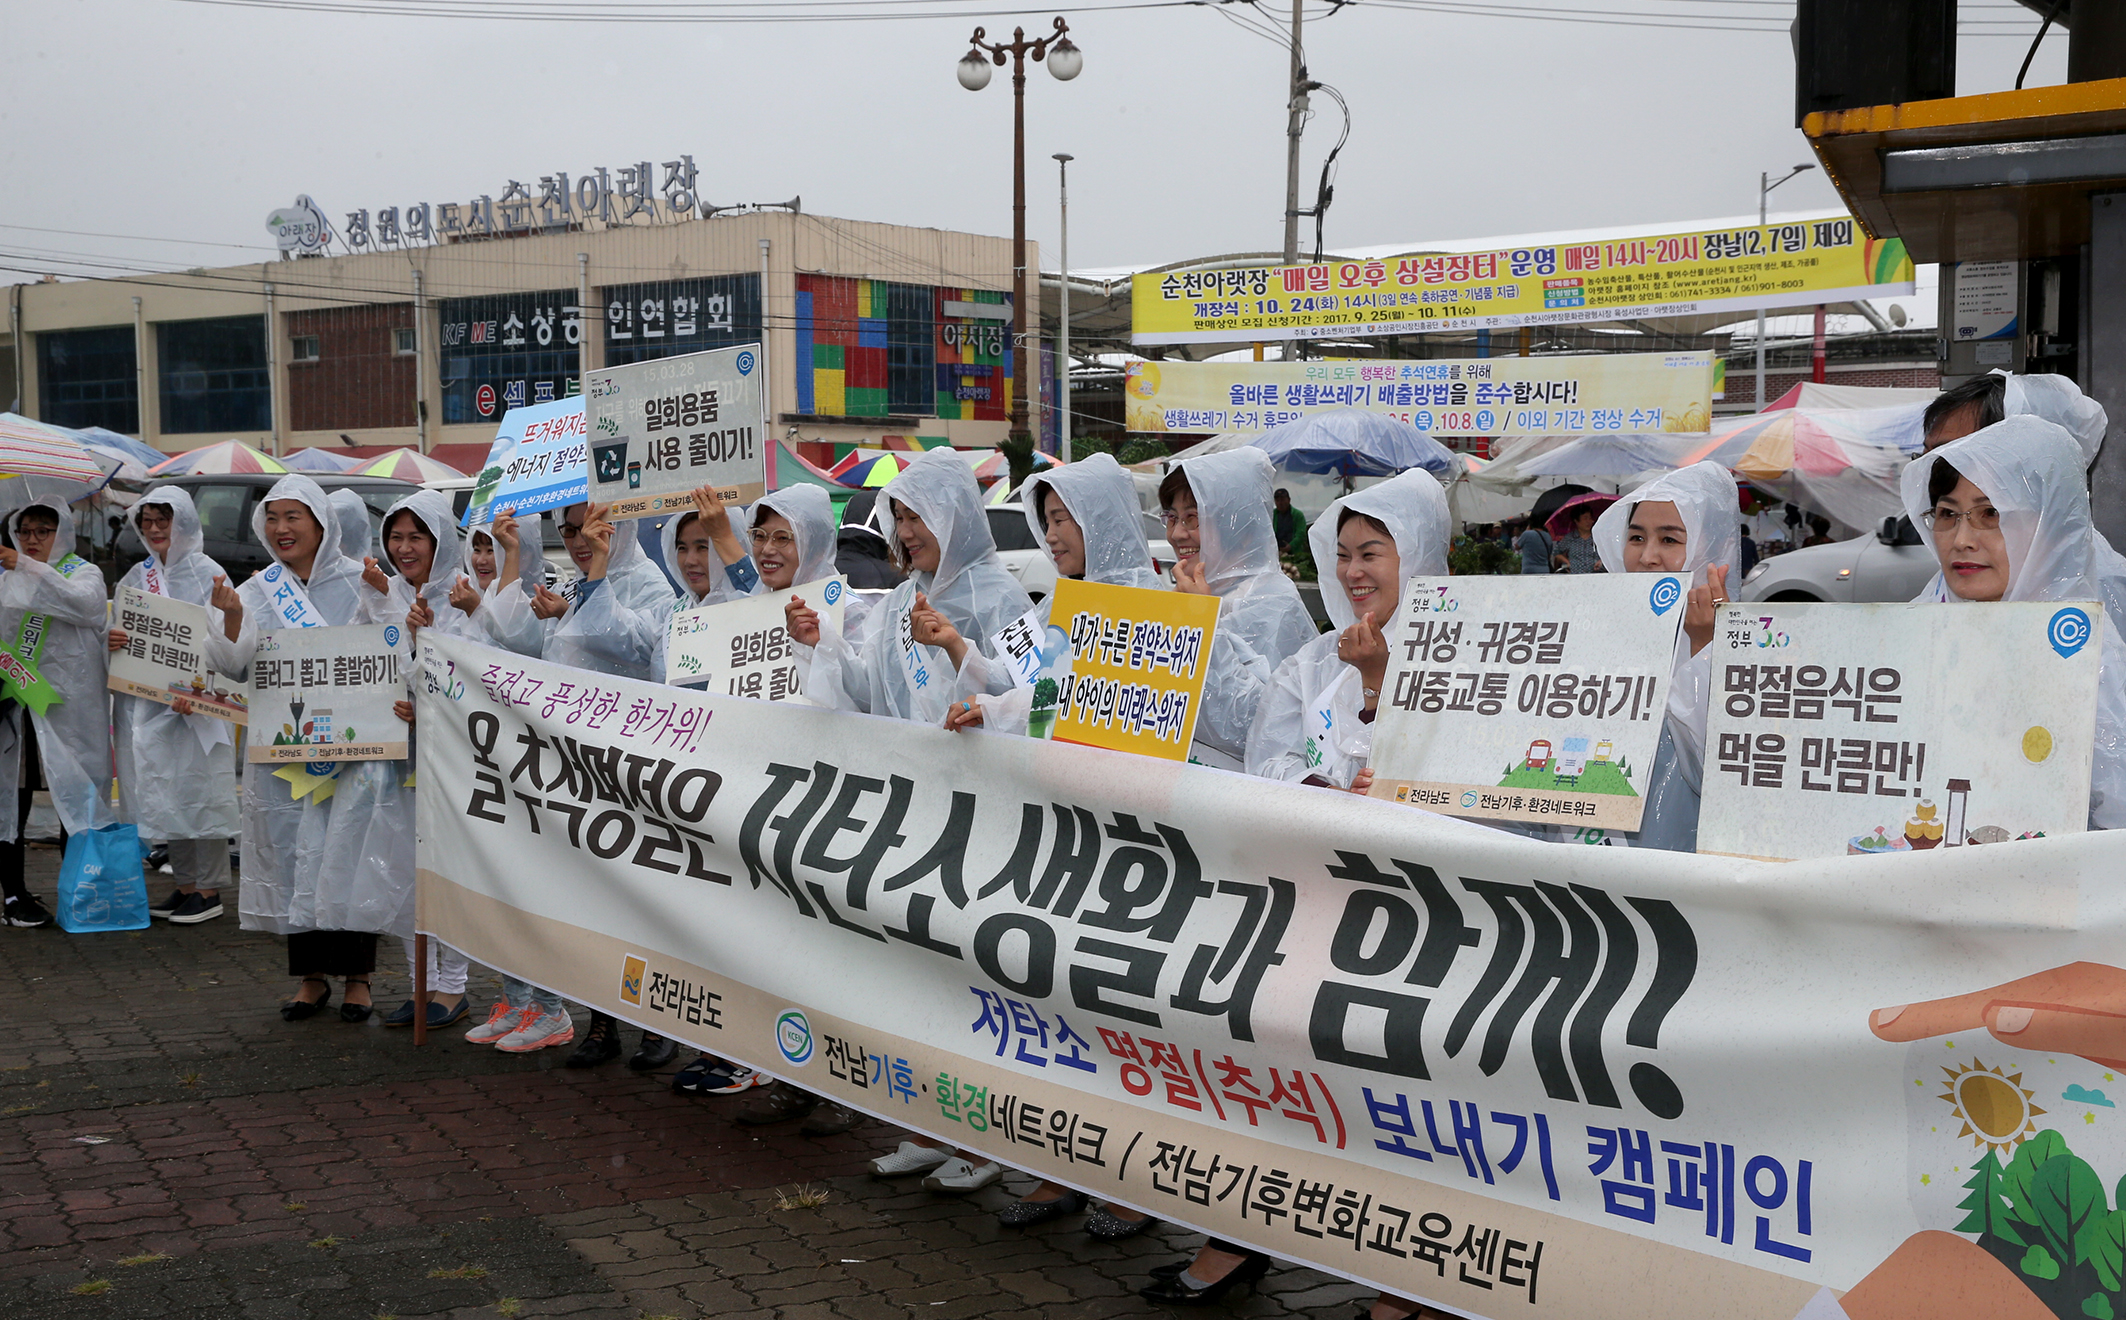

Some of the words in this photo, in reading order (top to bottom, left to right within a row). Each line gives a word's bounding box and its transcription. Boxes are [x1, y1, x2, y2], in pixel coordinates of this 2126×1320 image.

[1162, 269, 1268, 298] 순천아랫장
[1339, 262, 1386, 288] 오후
[1565, 245, 1600, 271] 매일
[1813, 220, 1852, 248] 제외
[1194, 302, 1238, 318] 개장식
[1256, 300, 1283, 314] 10.
[1400, 291, 1418, 306] 연속
[1496, 284, 1520, 299] 지급)
[1194, 318, 1238, 330] 판매상인
[1240, 318, 1263, 328] 모집
[1266, 315, 1312, 326] 신청기간
[943, 324, 1005, 356] 야시장
[1306, 366, 1328, 381] 우리
[1332, 366, 1356, 380] 모두
[1360, 366, 1396, 382] 행복한
[1400, 364, 1462, 382] 추석연휴를
[1466, 364, 1492, 380] 위해
[645, 390, 718, 432] 일회용품
[1229, 384, 1279, 406] 올바른
[1284, 384, 1370, 407] 생활쓰레기
[1378, 382, 1468, 406] 배출방법을
[1475, 381, 1578, 406] 준수합시다!
[1164, 410, 1228, 429] 생활쓰레기
[1232, 410, 1258, 429] 수거
[1517, 411, 1547, 430] 이외
[1552, 410, 1586, 429] 기간
[1590, 408, 1624, 430] 정상
[1628, 408, 1662, 428] 수거
[644, 436, 682, 471] 사용
[688, 426, 754, 467] 줄이기!
[506, 452, 552, 482] 에너지
[620, 502, 646, 514] 전라남도
[1412, 598, 1430, 613] 정부
[1432, 586, 1459, 612] 3.0
[122, 609, 192, 648] 명절음식은
[677, 626, 689, 636] 정부
[1726, 630, 1752, 649] 정부
[1756, 617, 1790, 648] 3.0
[151, 642, 200, 675] 만큼만!
[1070, 615, 1099, 662] 내가
[1100, 619, 1130, 664] 누른
[1131, 624, 1202, 677] 절약스위치
[255, 659, 296, 690] 플러그
[300, 657, 328, 688] 뽑고
[333, 654, 398, 687] 출발하기!
[424, 670, 441, 694] 정부
[480, 664, 544, 708] 즐겁고
[541, 682, 622, 730] 풍성한
[619, 697, 714, 754] 한가위!
[1058, 675, 1075, 718] 내
[1076, 678, 1116, 727] 아이의
[1117, 686, 1190, 742] 미래스위치
[1392, 670, 1510, 716] 대중교통
[1517, 674, 1656, 722] 이용하기!
[1724, 664, 1902, 724] 명절음식은
[278, 750, 302, 758] 전라남도
[1718, 732, 1787, 790] 먹을
[1800, 736, 1926, 799] 만큼만!
[1410, 789, 1450, 805] 전라남도
[738, 760, 1297, 1044] 저탄소생활과
[1308, 849, 1699, 1120] 함께!
[648, 970, 724, 1030] 전라남도
[1148, 1139, 1545, 1305] 전남기후변화교육센터
[969, 985, 1098, 1074] 저탄소
[1096, 1025, 1347, 1150] 명절(추석)
[1361, 1086, 1562, 1203] 보내기
[1584, 1123, 1813, 1265] 캠페인
